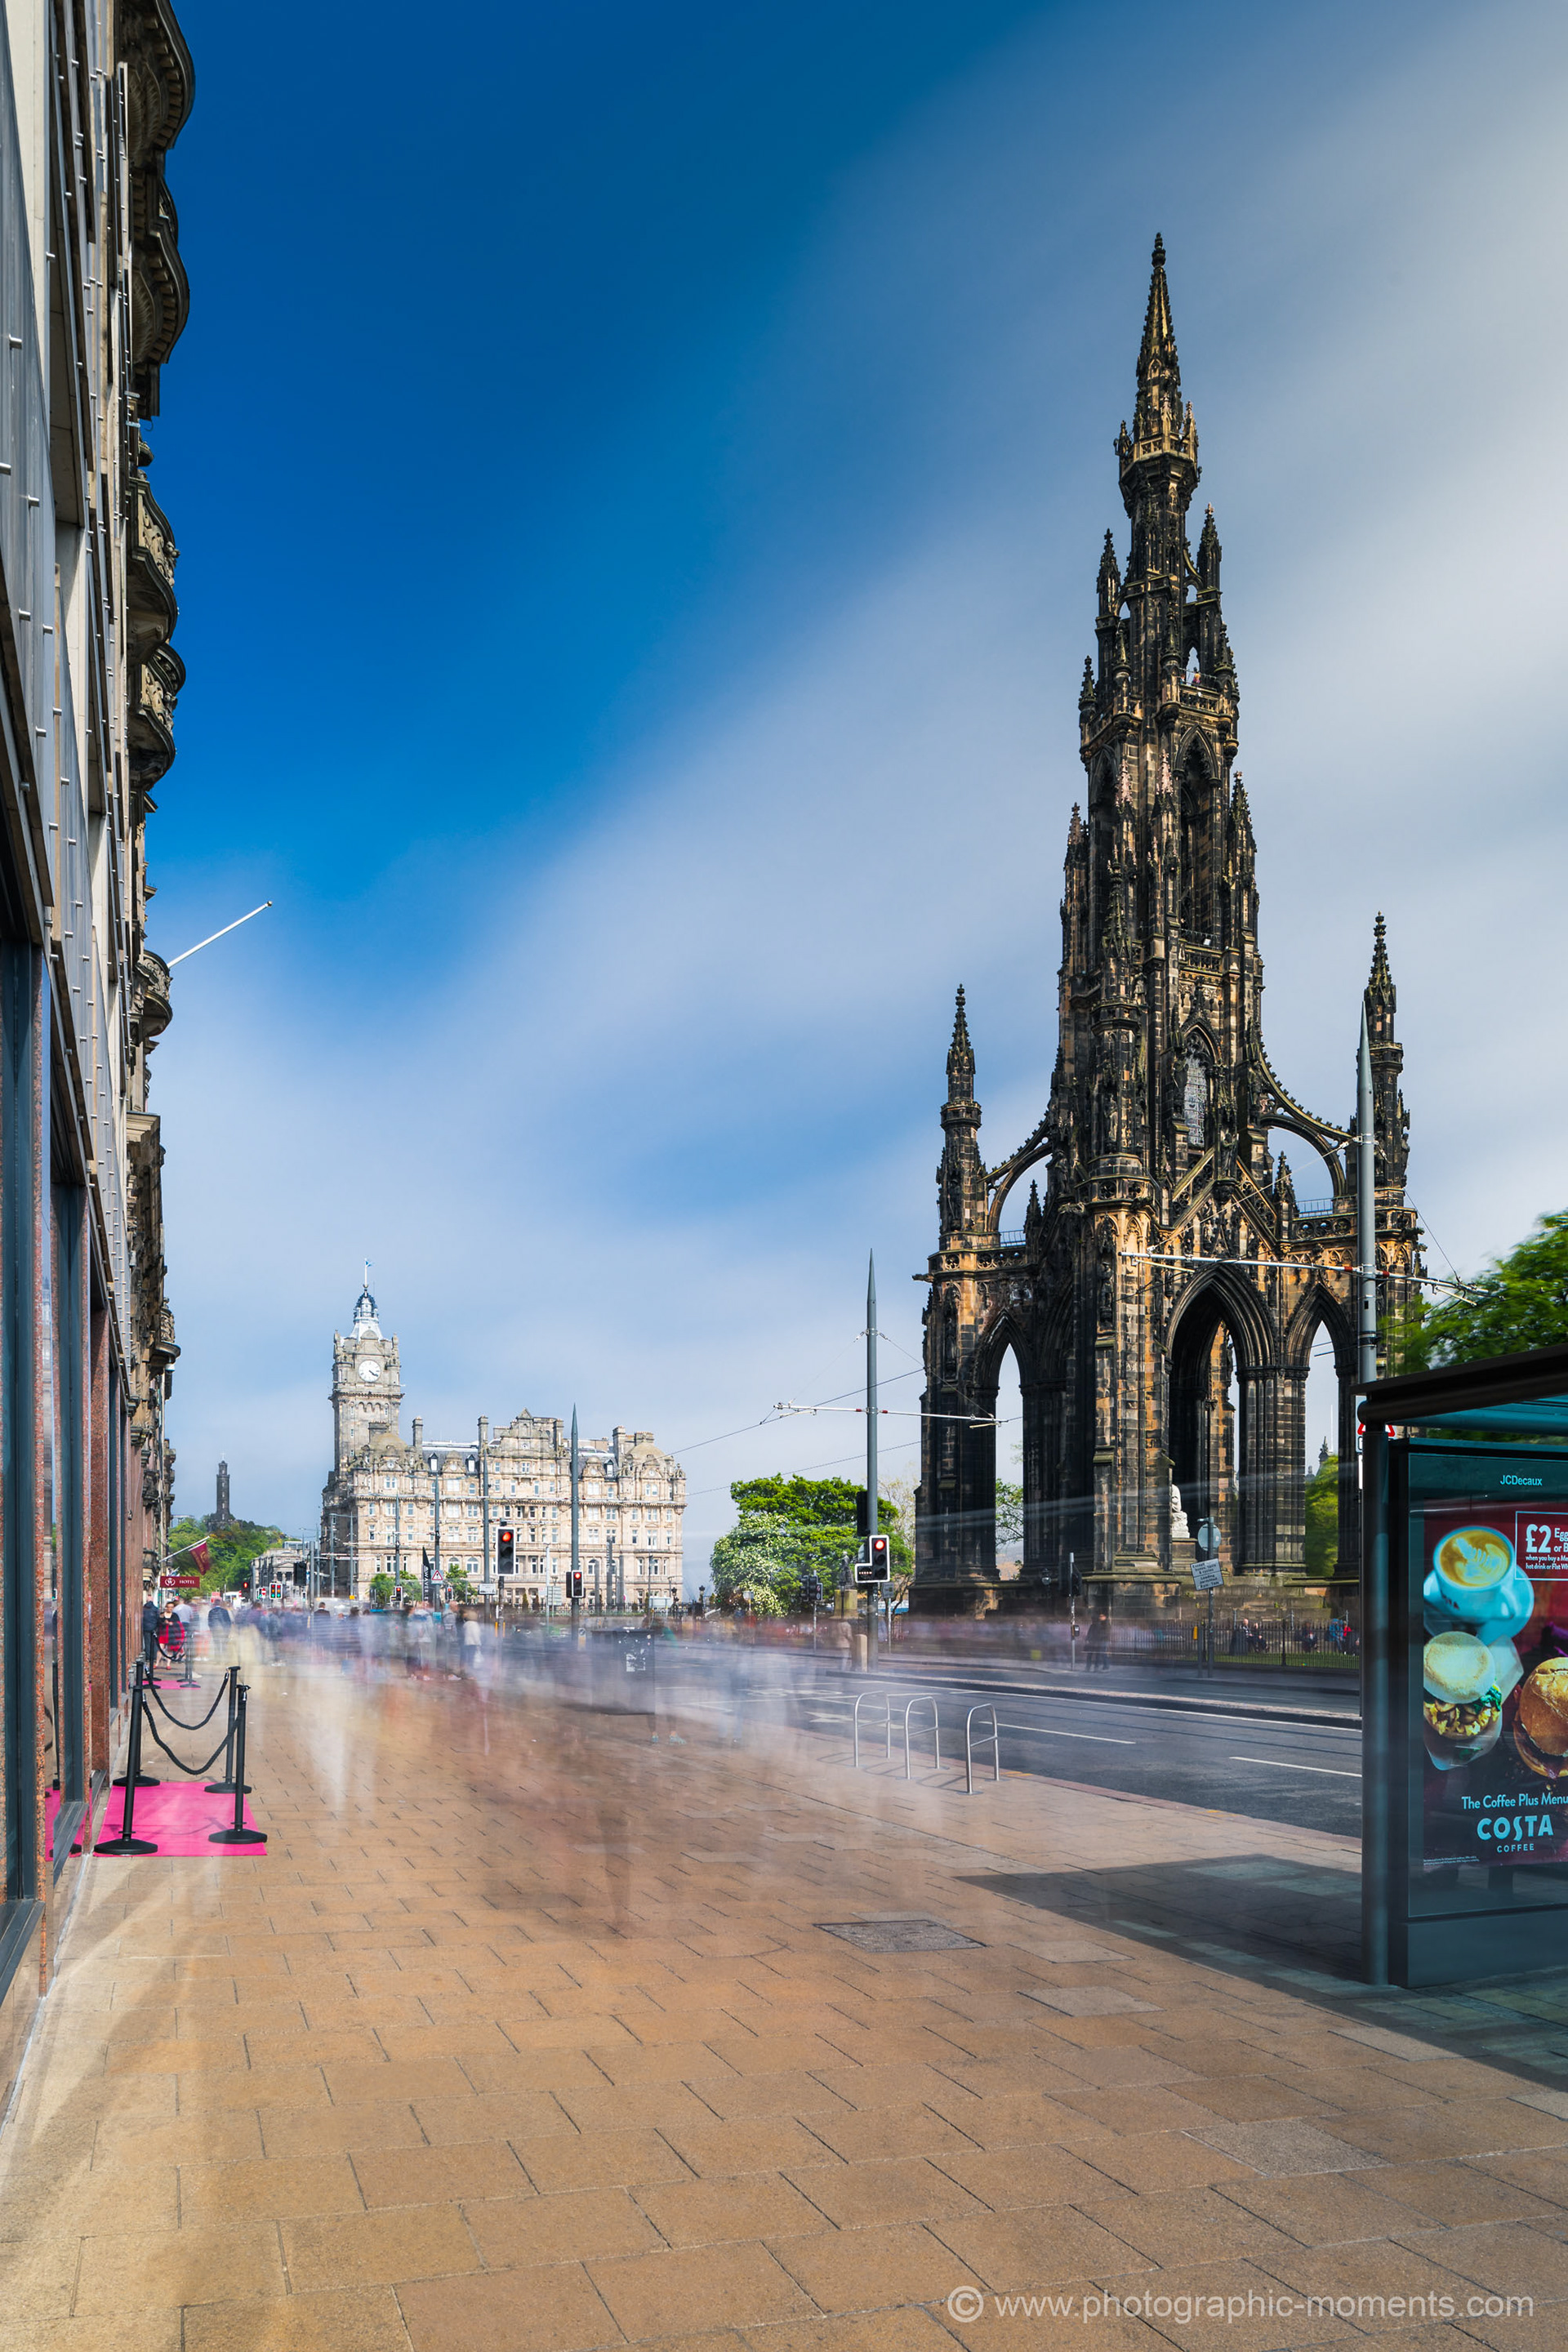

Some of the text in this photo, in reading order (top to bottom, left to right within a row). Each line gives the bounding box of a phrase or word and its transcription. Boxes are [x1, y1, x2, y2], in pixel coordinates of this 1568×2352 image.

[1500, 1475, 1543, 1486] JCDecaux
[1526, 1524, 1552, 1553] £2
[1548, 1555, 1557, 1563] buy
[1461, 1792, 1568, 1810] The Coffee Plus Menu
[1477, 1815, 1554, 1842] COSTA
[1497, 1843, 1535, 1853] COFFEE
